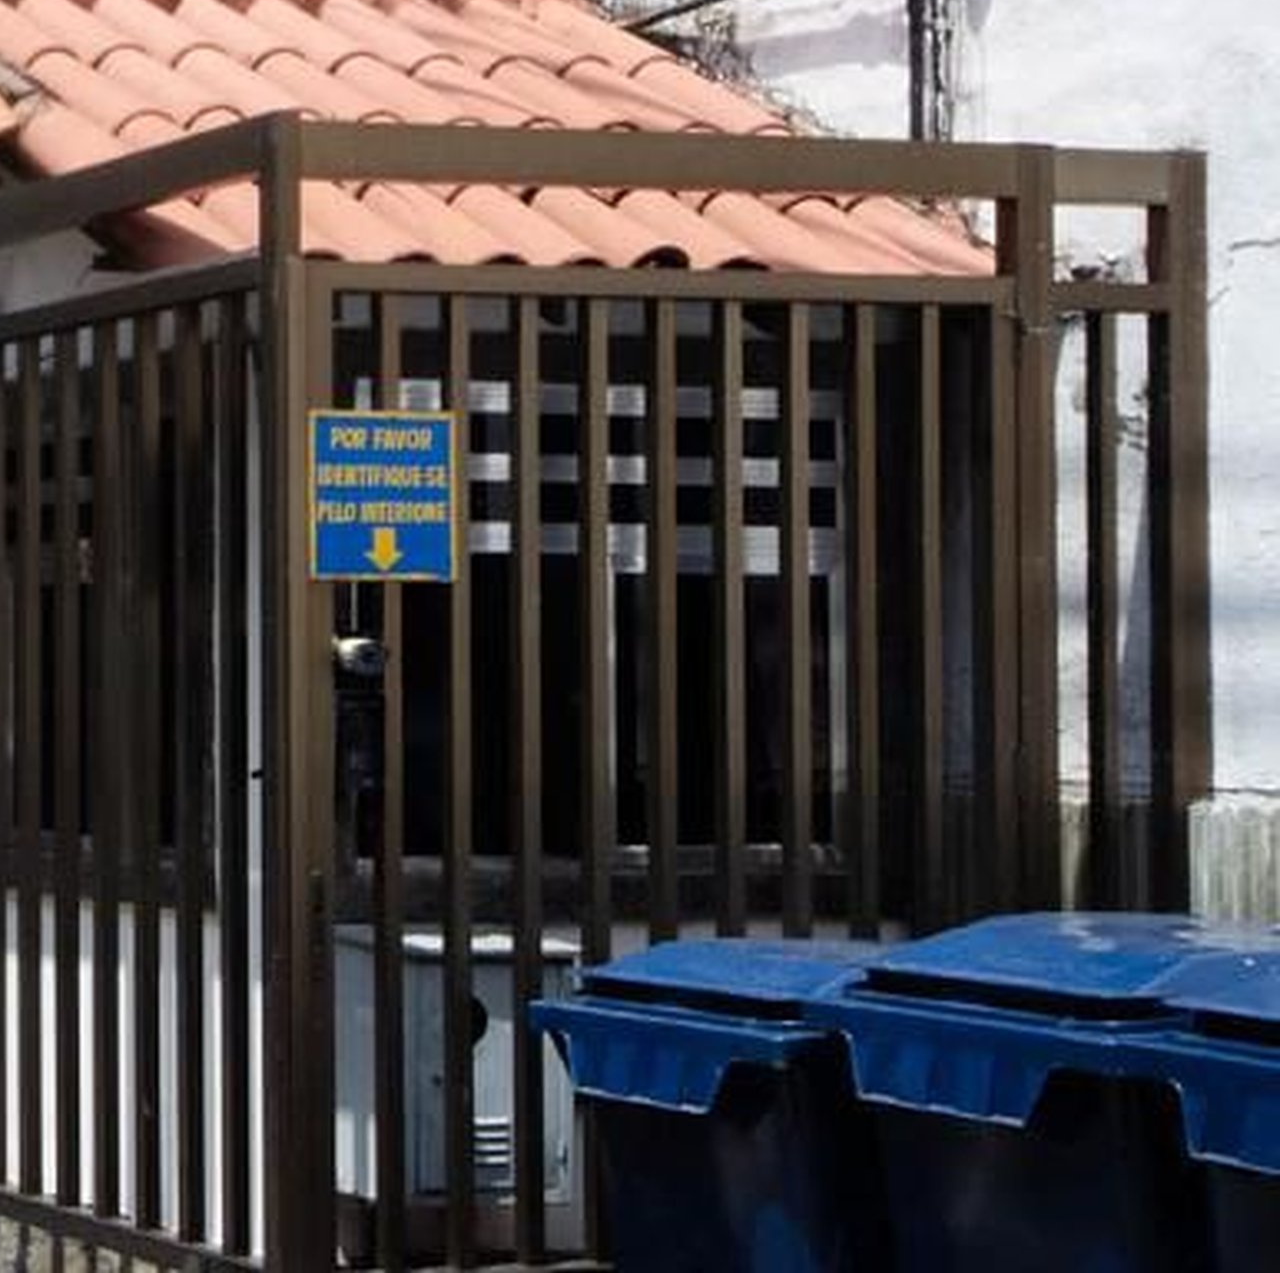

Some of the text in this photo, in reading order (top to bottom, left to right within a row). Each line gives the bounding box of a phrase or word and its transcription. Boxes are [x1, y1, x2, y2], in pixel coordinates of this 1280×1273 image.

[330, 427, 433, 451] POR FAVOR
[317, 464, 447, 489] IDENTIFIQUE-SE
[317, 501, 357, 524] PELO
